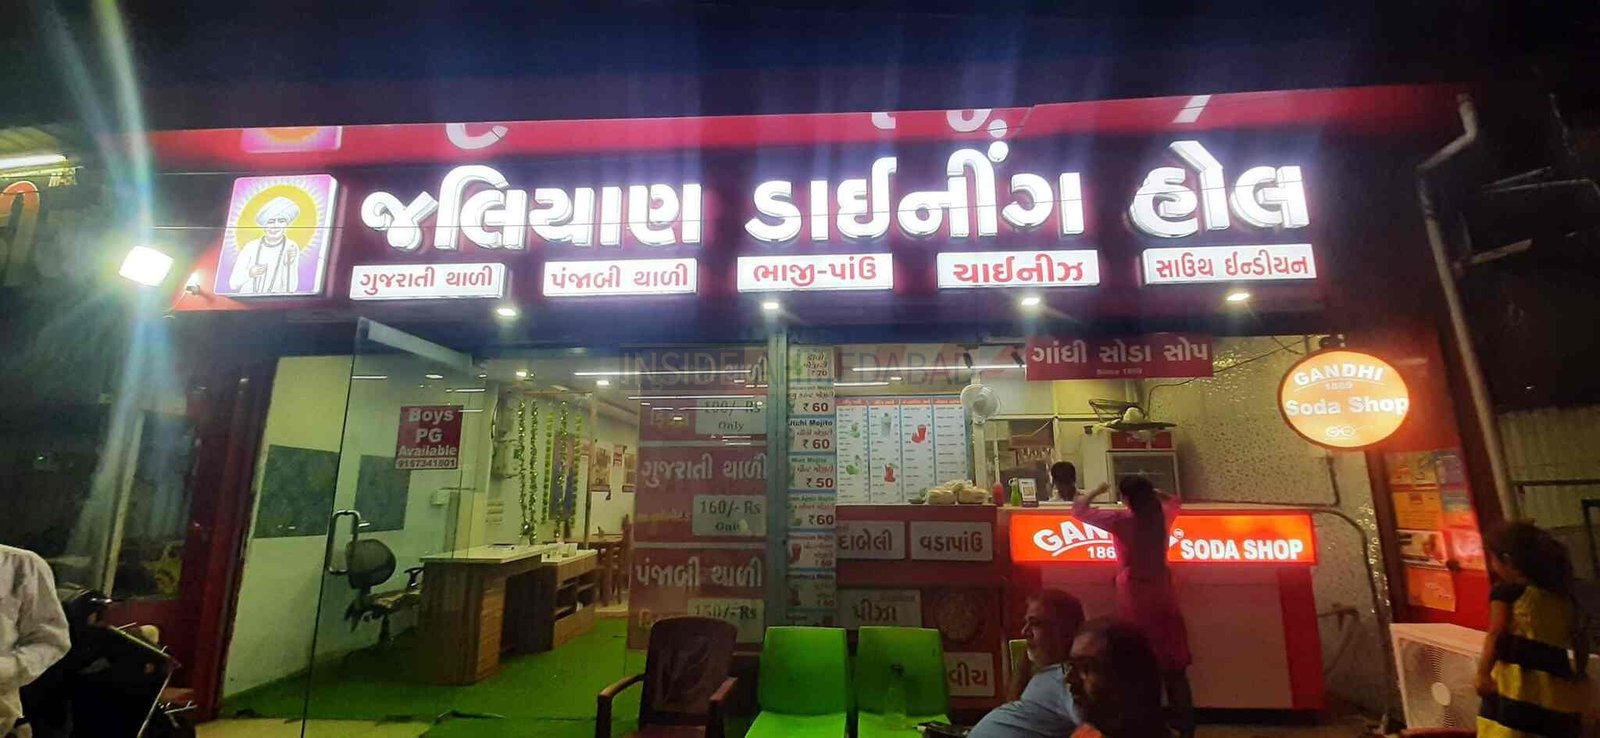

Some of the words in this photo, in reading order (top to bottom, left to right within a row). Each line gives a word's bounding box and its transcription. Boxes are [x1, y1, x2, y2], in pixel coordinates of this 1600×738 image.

[361, 165, 702, 250] જલિયાણ
[744, 141, 1086, 242] ડાઈનીંગ
[1130, 140, 1310, 238] હોલ
[953, 253, 1083, 283] ચાઈનીઝ
[1156, 252, 1214, 277] સાઉથ
[360, 266, 435, 295] ગુજરાતી
[446, 265, 493, 287] થાળી
[551, 265, 621, 289] પંજાબી
[634, 264, 689, 287] થાળી
[1032, 339, 1087, 364] ગાંધી
[1099, 339, 1150, 362] સોડા
[1163, 336, 1207, 361] સોપ
[1294, 362, 1384, 386] GANDHI
[704, 401, 742, 417] 100/
[812, 402, 828, 412] 60
[1286, 399, 1341, 416] Soda
[1349, 395, 1409, 416] Shop
[408, 408, 454, 425] Boys
[718, 420, 744, 432] Only
[416, 428, 443, 443] PG
[812, 438, 830, 449] 60
[398, 445, 457, 456] Available
[640, 453, 713, 487] ગુજરાતી
[723, 452, 767, 479] થાળી
[816, 478, 833, 488] 50
[701, 500, 739, 517] 160/-
[744, 500, 760, 514] Rs
[838, 528, 893, 551] દાબેલી
[1180, 538, 1240, 560] SODA
[1243, 539, 1304, 560] SHOP
[1087, 547, 1117, 560] 186
[635, 556, 701, 587] પંજાબી
[710, 556, 762, 587] થાળી
[739, 604, 757, 620] Rs
[851, 598, 897, 622] પીઝા
